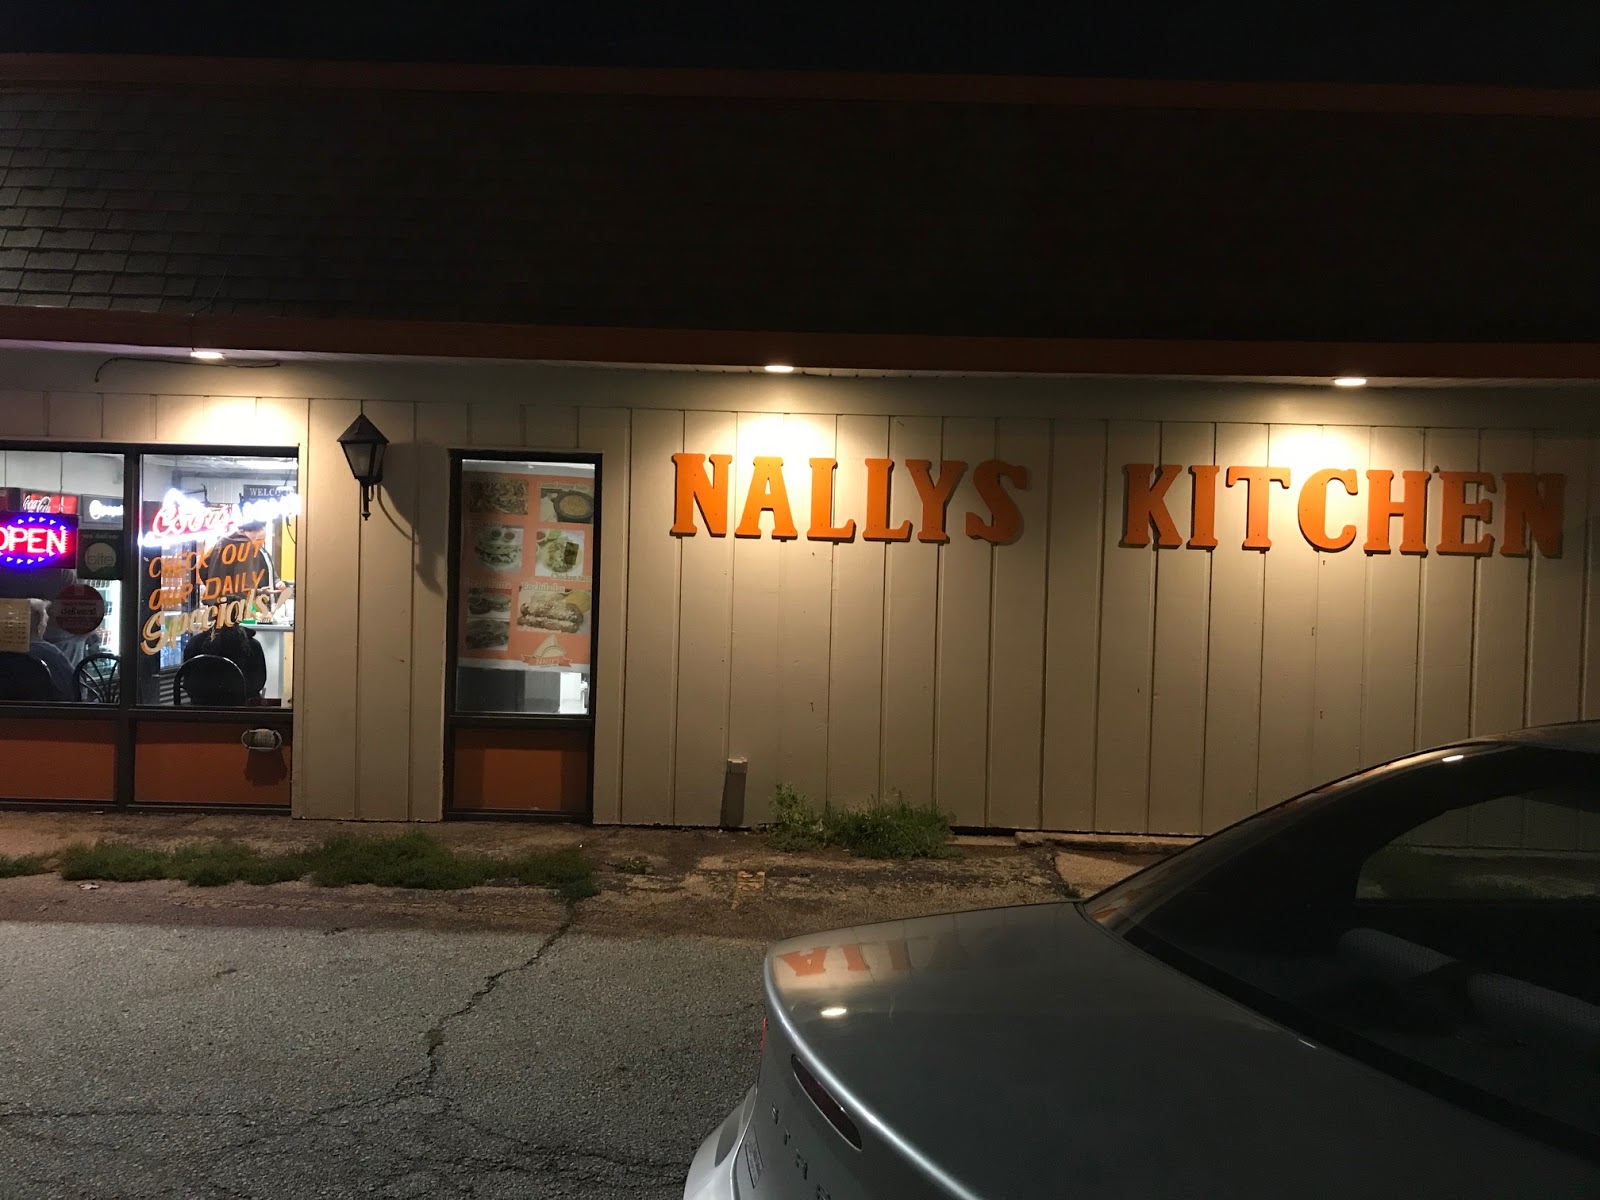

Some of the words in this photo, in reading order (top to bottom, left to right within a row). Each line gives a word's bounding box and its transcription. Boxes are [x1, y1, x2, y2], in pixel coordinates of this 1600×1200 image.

[249, 487, 294, 497] WELCO
[670, 453, 1028, 543] NALLYS
[1120, 464, 1566, 558] KITCHEN
[0, 527, 67, 554] OPEN
[148, 545, 214, 578] CHECK
[221, 538, 265, 565] OUT
[148, 582, 194, 610] OUR
[202, 568, 265, 600] DAILY
